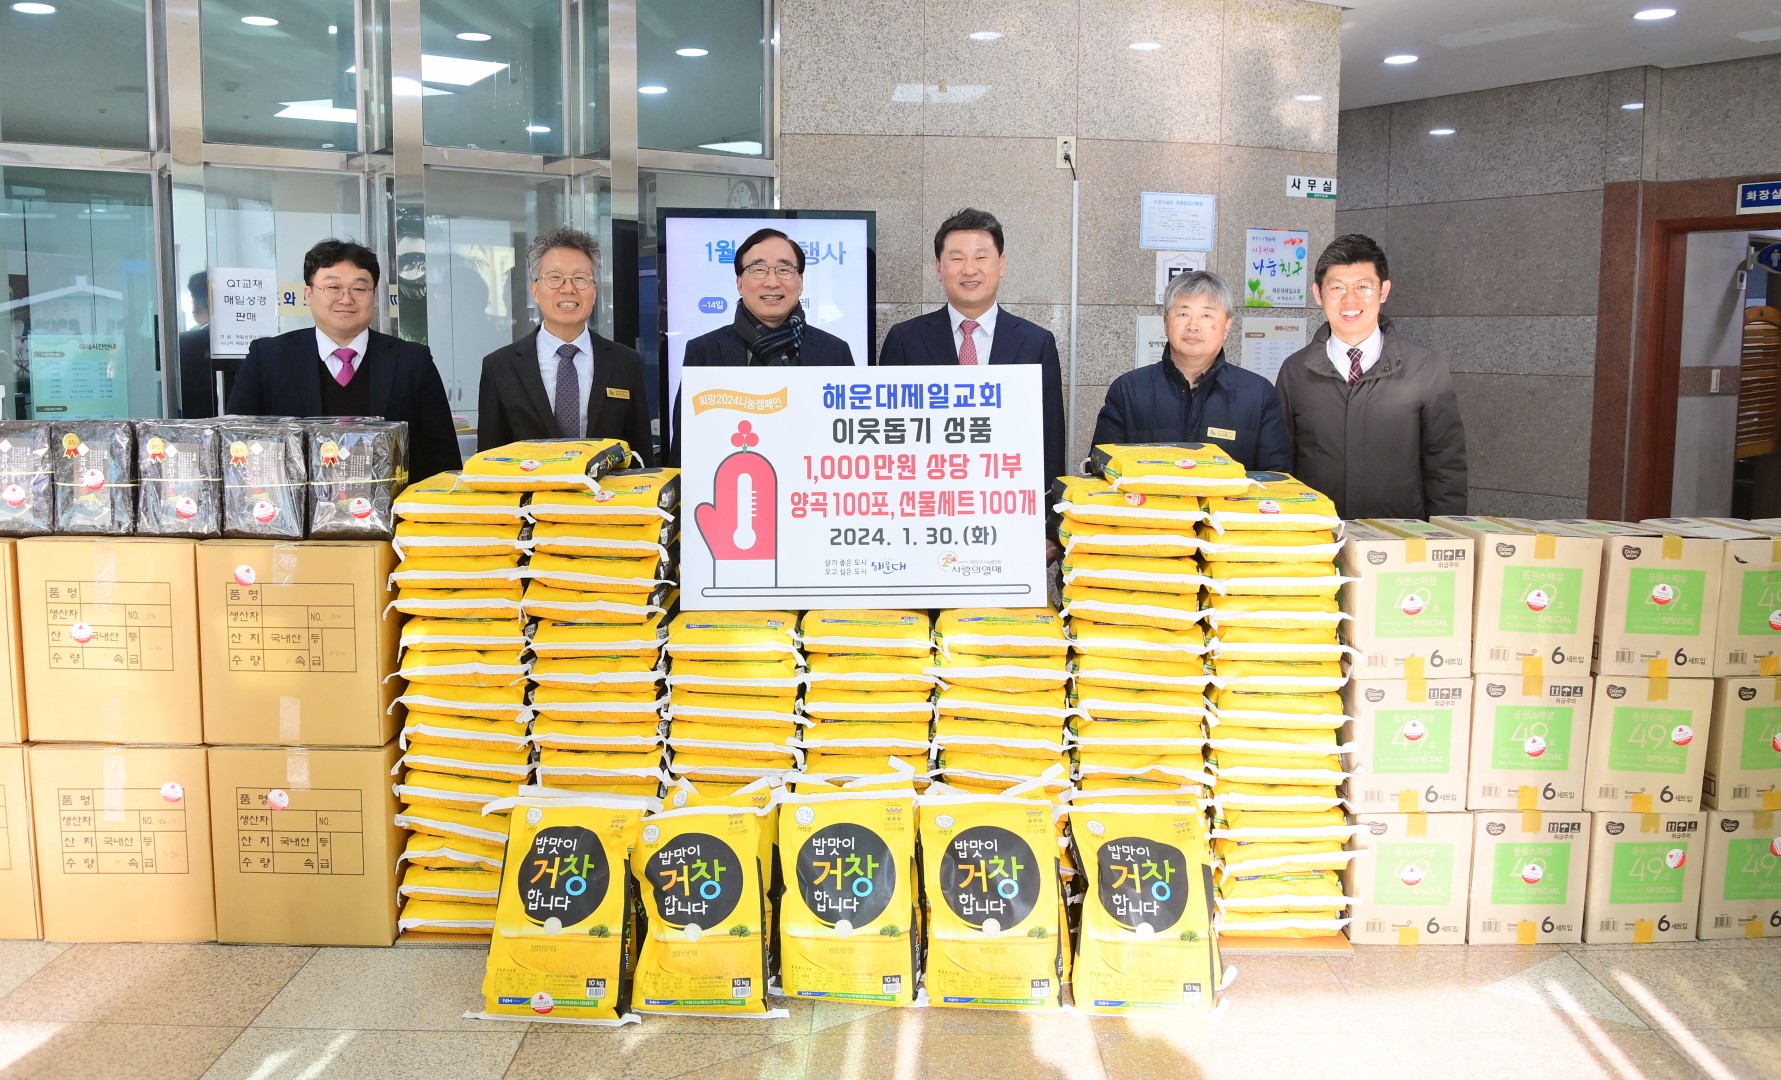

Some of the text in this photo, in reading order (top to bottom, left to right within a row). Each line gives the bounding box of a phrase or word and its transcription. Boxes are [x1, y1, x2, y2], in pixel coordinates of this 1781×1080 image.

[1291, 178, 1332, 192] 사무실
[1745, 189, 1781, 201] 화장실
[227, 279, 262, 289] QT교재
[224, 296, 266, 305] 매일성경
[702, 301, 724, 310] ~14일
[236, 312, 256, 321] 판매
[822, 382, 1002, 410] 해운대제일교회
[832, 417, 992, 444] 이웃돕기 성품
[804, 452, 1022, 484] 1,000만원 상당 기부
[830, 527, 891, 546] 2024.
[952, 566, 1001, 576] 사랑의열매
[49, 609, 78, 619] 생산자
[229, 611, 259, 622] 생산자
[311, 613, 322, 621] NO.
[1662, 616, 1695, 625] SPECIAL
[271, 633, 301, 644] 국내산
[113, 654, 124, 664] 속
[295, 656, 305, 666] 속
[63, 816, 92, 826] 생산자
[240, 816, 269, 826] 생산자
[320, 817, 331, 826] NO.
[104, 837, 134, 847] 국내산
[280, 837, 310, 847] 국내산
[535, 836, 577, 856] 밥맛이
[812, 837, 856, 856] 밥맛이
[954, 839, 998, 858] 밥맛이
[1107, 845, 1150, 862] 밥맛이
[659, 845, 701, 865] 밥맛이
[128, 858, 138, 868] 속
[304, 858, 314, 869] 속
[530, 853, 595, 897] 거창
[660, 859, 727, 900] 거창
[812, 854, 879, 898] 거창
[958, 855, 1024, 899] 거창
[1109, 859, 1176, 902] 거창
[527, 888, 571, 912] 합니다
[664, 895, 708, 916] 합니다
[814, 890, 859, 913] 합니다
[958, 893, 1006, 915] 합니다
[1111, 893, 1160, 916] 합니다
[1192, 984, 1200, 992] kg
